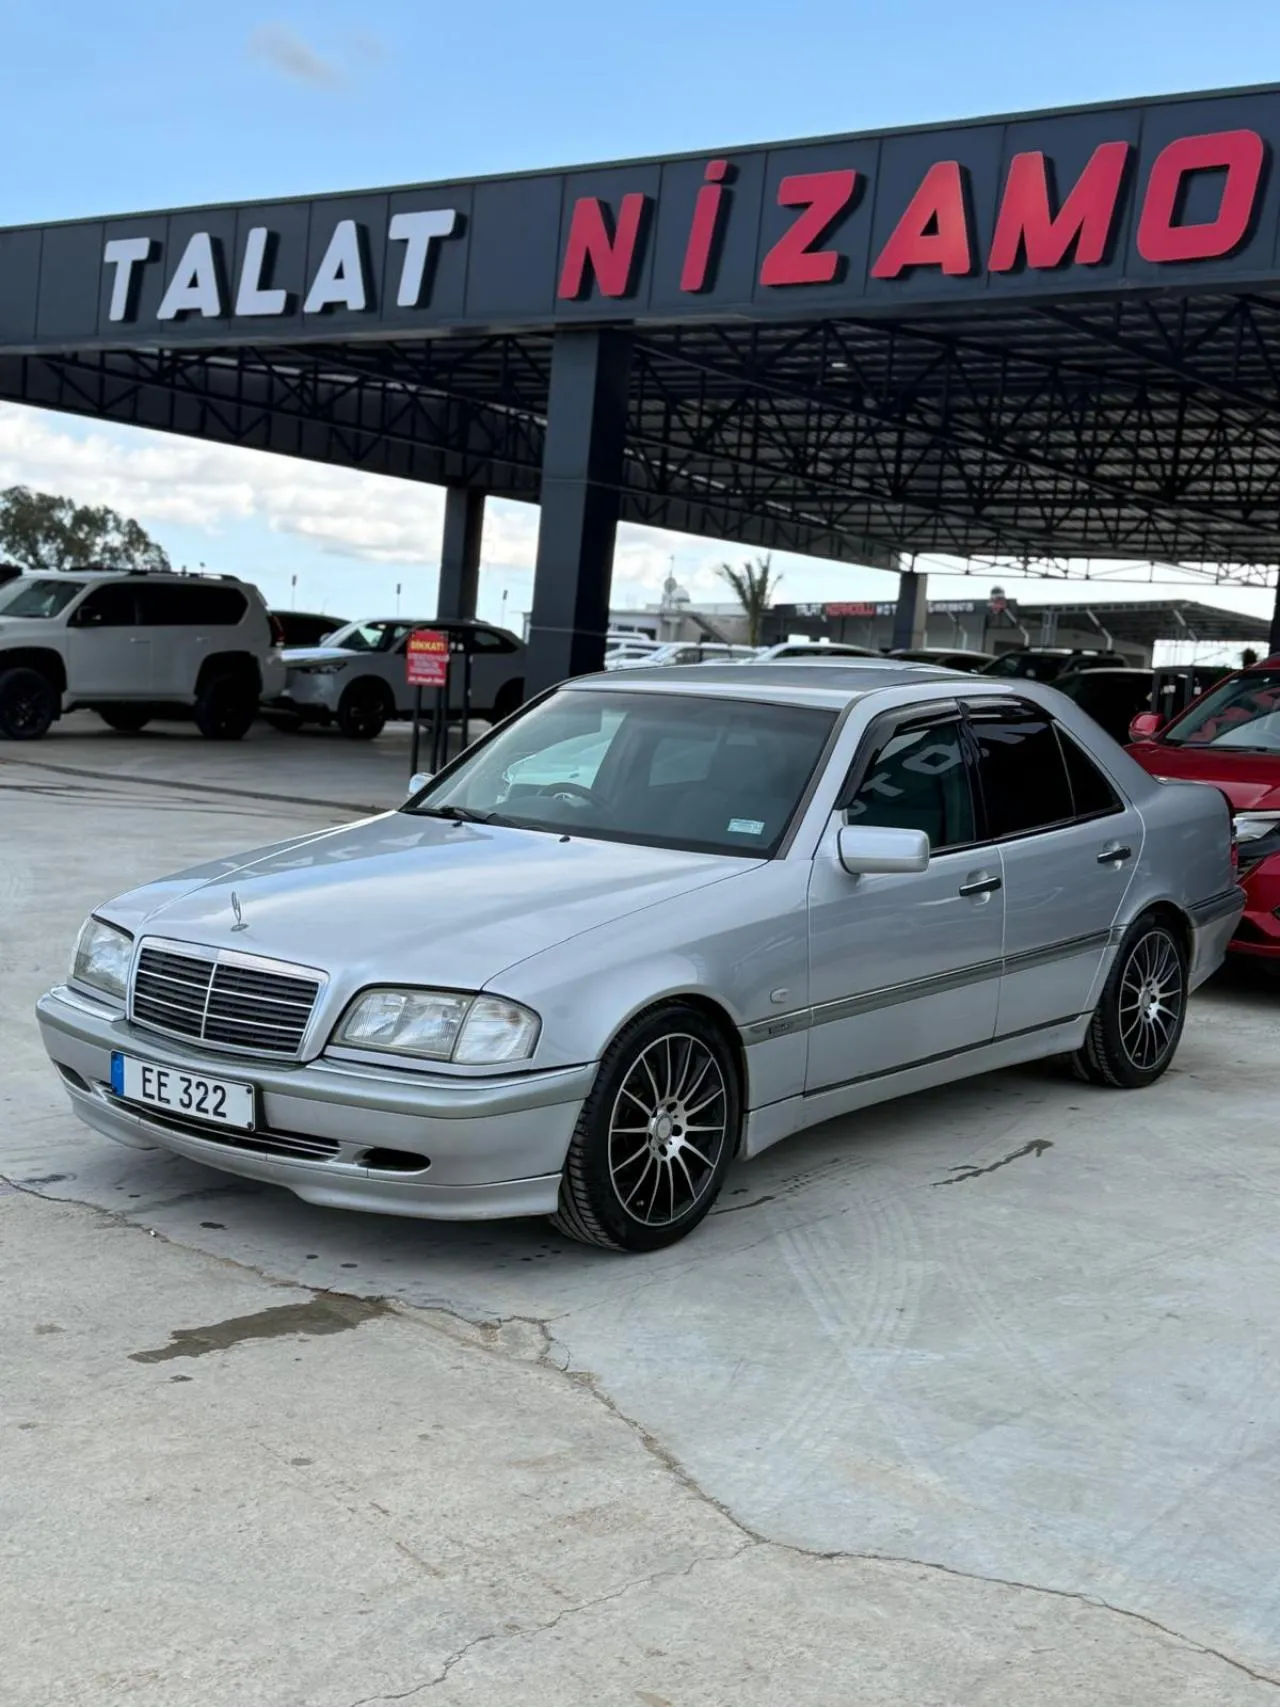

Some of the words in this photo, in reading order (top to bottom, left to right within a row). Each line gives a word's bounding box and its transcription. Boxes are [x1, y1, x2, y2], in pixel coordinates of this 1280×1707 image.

[104, 208, 457, 322] TALAT
[557, 128, 1265, 299] NİZAMO
[141, 1066, 171, 1105] EE
[178, 1076, 227, 1118] 322
